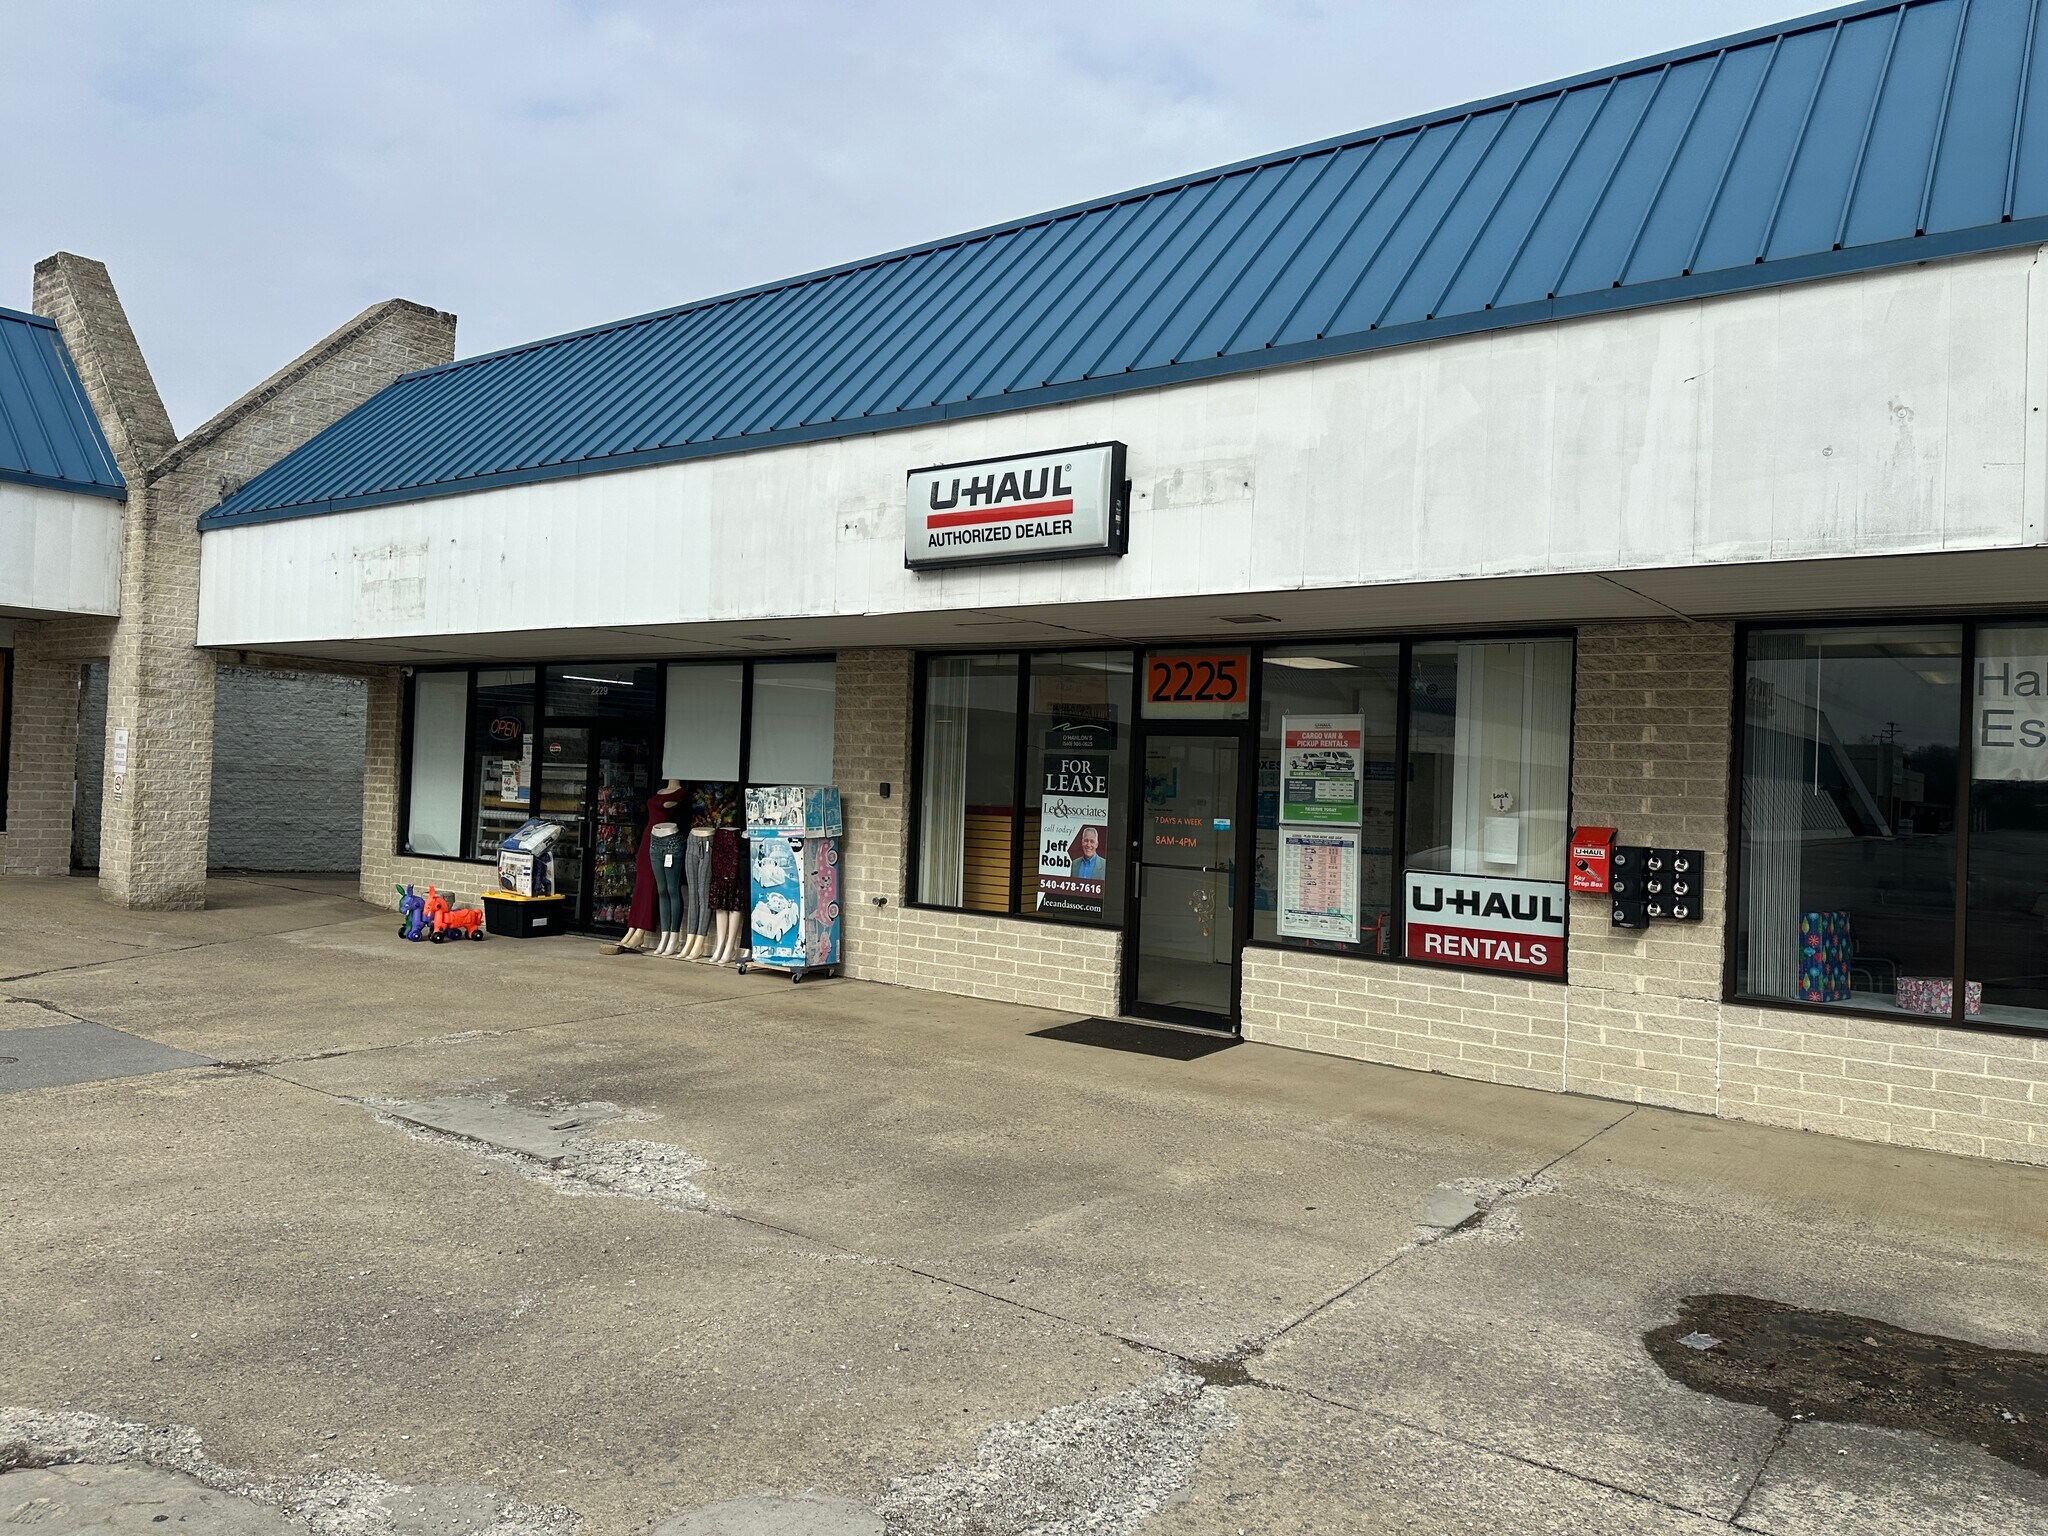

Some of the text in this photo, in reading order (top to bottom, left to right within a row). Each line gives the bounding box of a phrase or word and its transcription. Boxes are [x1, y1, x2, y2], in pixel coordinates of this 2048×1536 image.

[930, 465, 1072, 510] U-HAUL
[928, 519, 1072, 547] AUTHORIZED DEALER
[1152, 660, 1238, 702] 2225
[590, 686, 608, 695] 2229
[490, 719, 520, 738] OPEN
[1981, 709, 2047, 748] Es
[1061, 759, 1092, 774] FOR
[1045, 773, 1106, 794] LEASE
[1160, 817, 1177, 825] DAYS
[1184, 818, 1203, 826] WEEK
[1043, 824, 1076, 836] call today!
[1045, 839, 1069, 854] Jeff
[1155, 836, 1197, 848] 8AM-4PM
[1041, 854, 1071, 868] Robb
[1040, 880, 1102, 894] 540-478-7616
[1573, 880, 1590, 888] Drop
[1043, 897, 1102, 913] leeandassoc.com
[1412, 886, 1563, 924] U-HAUL
[1424, 933, 1548, 966] RENTALS
